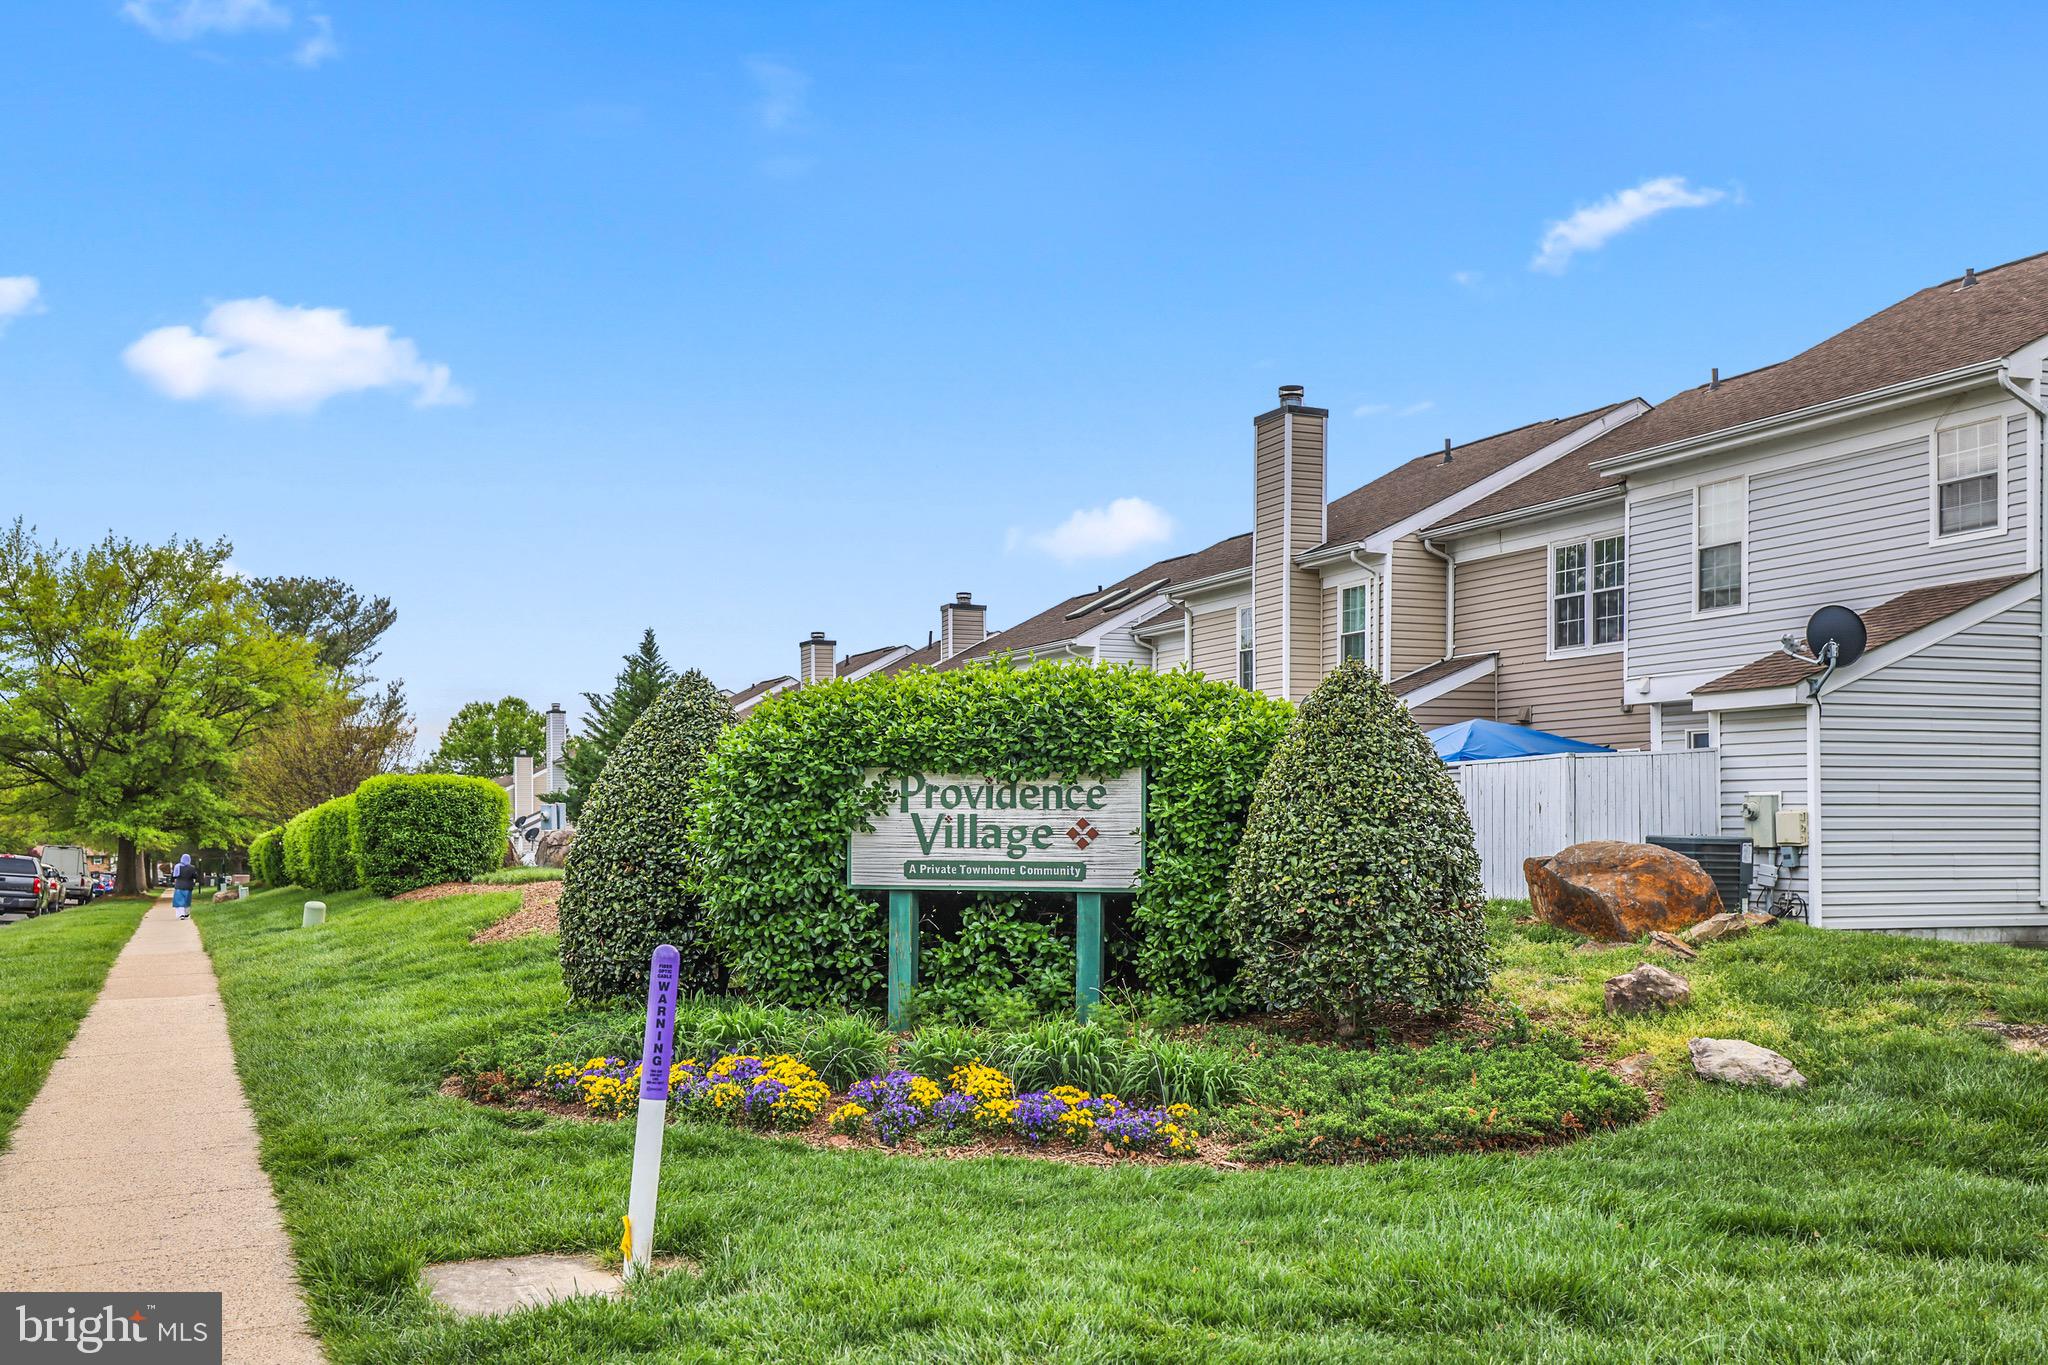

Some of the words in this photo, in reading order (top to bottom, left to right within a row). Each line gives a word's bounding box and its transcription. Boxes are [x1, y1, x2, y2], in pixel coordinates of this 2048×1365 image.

[899, 771, 1108, 813] Providence
[910, 813, 1055, 859] Village
[909, 864, 918, 874] A
[919, 864, 957, 875] Private
[959, 864, 1016, 875] Townhome
[1019, 865, 1082, 878] Community
[652, 981, 671, 1067] WARNING
